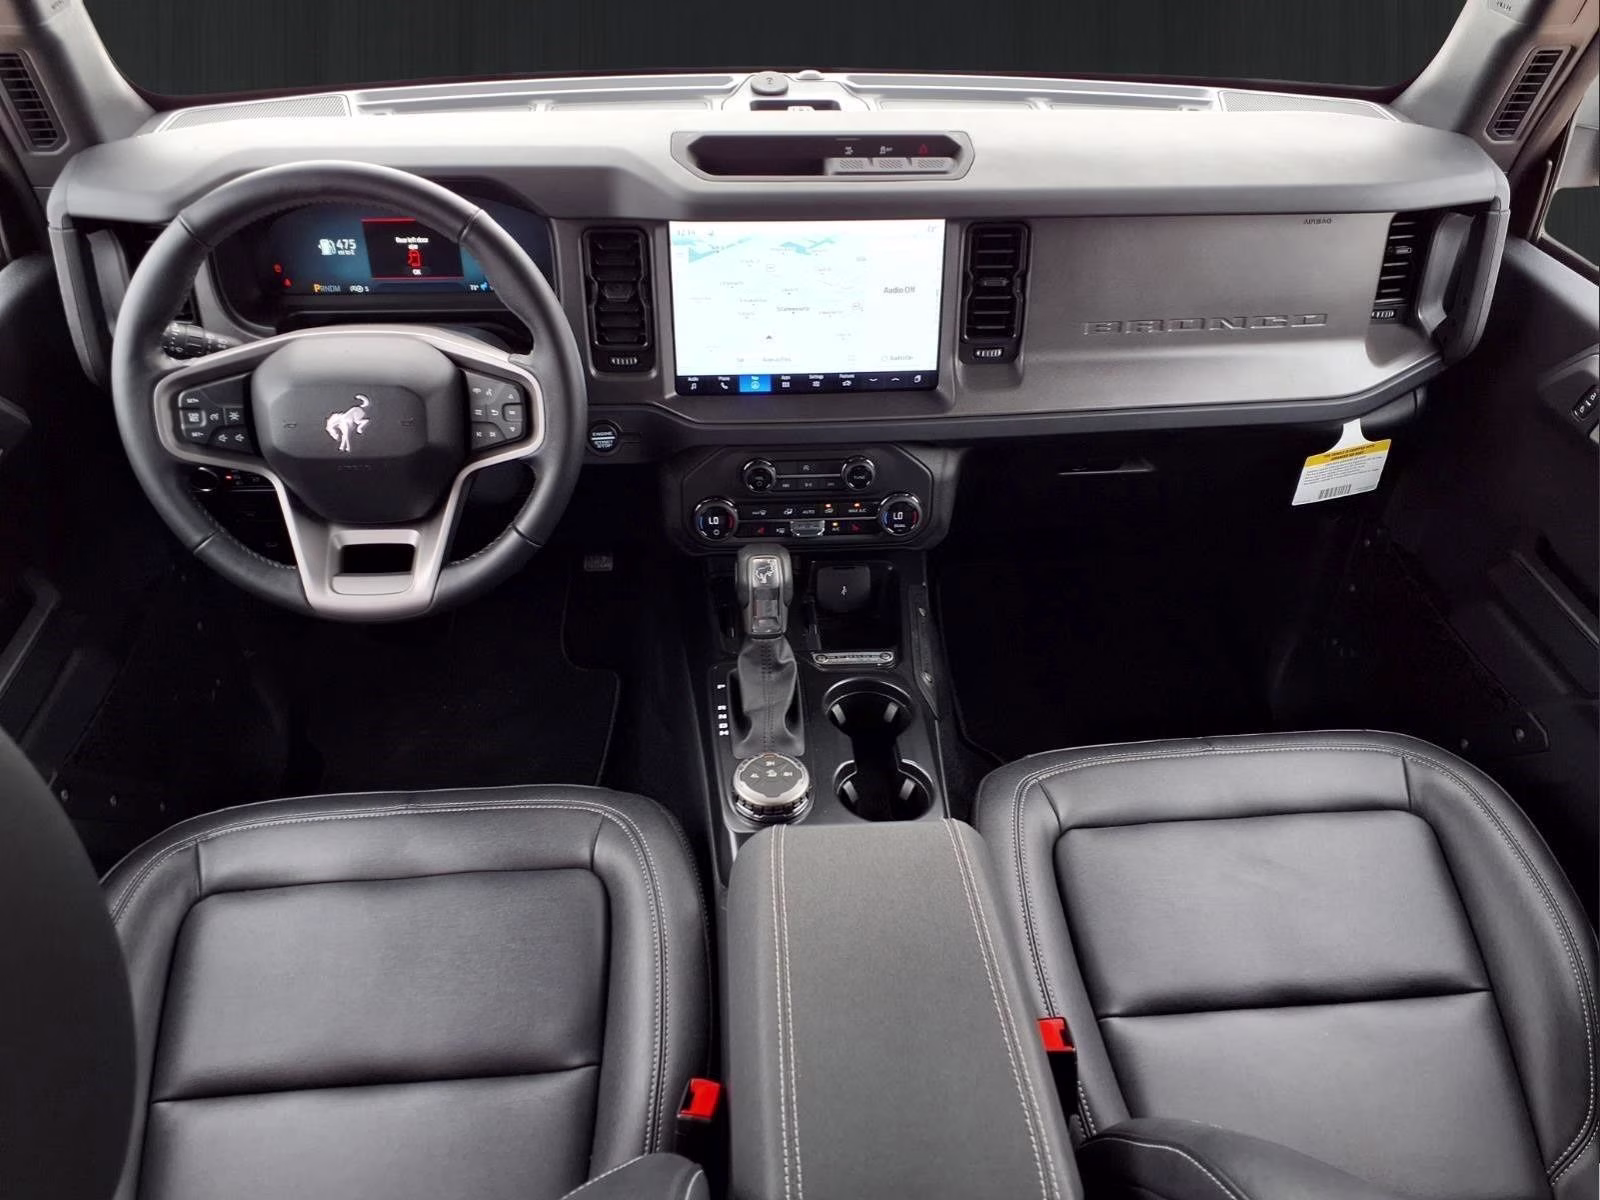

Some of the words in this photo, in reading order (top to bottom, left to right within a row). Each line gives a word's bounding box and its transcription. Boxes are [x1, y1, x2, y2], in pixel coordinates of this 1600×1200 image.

[1303, 217, 1332, 225] AIRBAG
[336, 239, 357, 250] 475
[883, 286, 904, 294] Audio
[904, 286, 916, 294] Off
[1082, 313, 1328, 336] BRONCO
[892, 511, 904, 520] LO
[708, 516, 720, 525] LO
